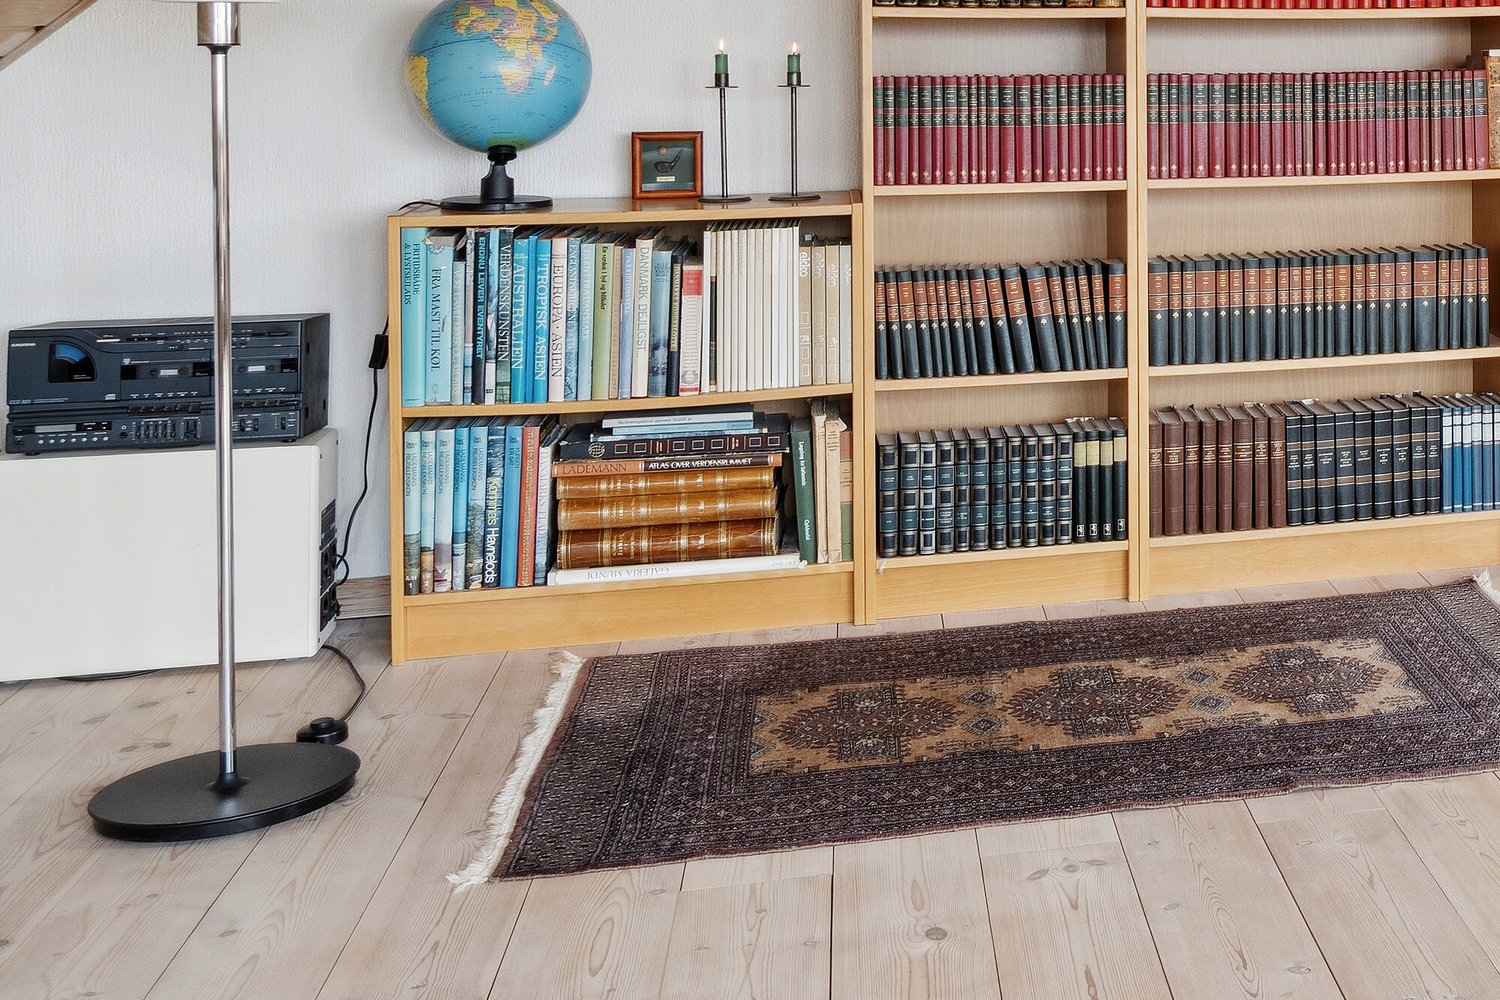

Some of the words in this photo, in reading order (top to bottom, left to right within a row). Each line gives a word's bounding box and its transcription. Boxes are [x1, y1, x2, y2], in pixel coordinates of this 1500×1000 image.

[413, 244, 421, 295] FRITIDSBÅDE
[432, 269, 442, 289] FRA
[639, 247, 649, 299] DANMARK
[800, 252, 810, 277] ekko
[814, 253, 824, 278] ekko
[828, 264, 838, 287] ekko
[431, 294, 440, 325] MAST
[498, 246, 511, 361] VERDENSKUNSTEN
[536, 264, 548, 330] TROPISK
[552, 265, 563, 323] EUROPA
[512, 264, 525, 368] AUSTRALIEN
[582, 296, 590, 341] DANMARK
[637, 305, 648, 357] DEJLIGST...
[431, 328, 440, 345] TIL
[431, 349, 441, 371] KØL
[453, 348, 460, 363] OG
[535, 337, 546, 380] ASIEN
[551, 334, 562, 377] ASIEN
[539, 450, 547, 506] DANMARKS
[563, 463, 627, 474] LADEMANN
[649, 460, 669, 469] ATLAS
[691, 457, 752, 467] VERDENSRUMMET
[485, 528, 499, 583] Havnelods
[625, 567, 668, 578] GALERIA
[586, 570, 623, 579] MUNDI
